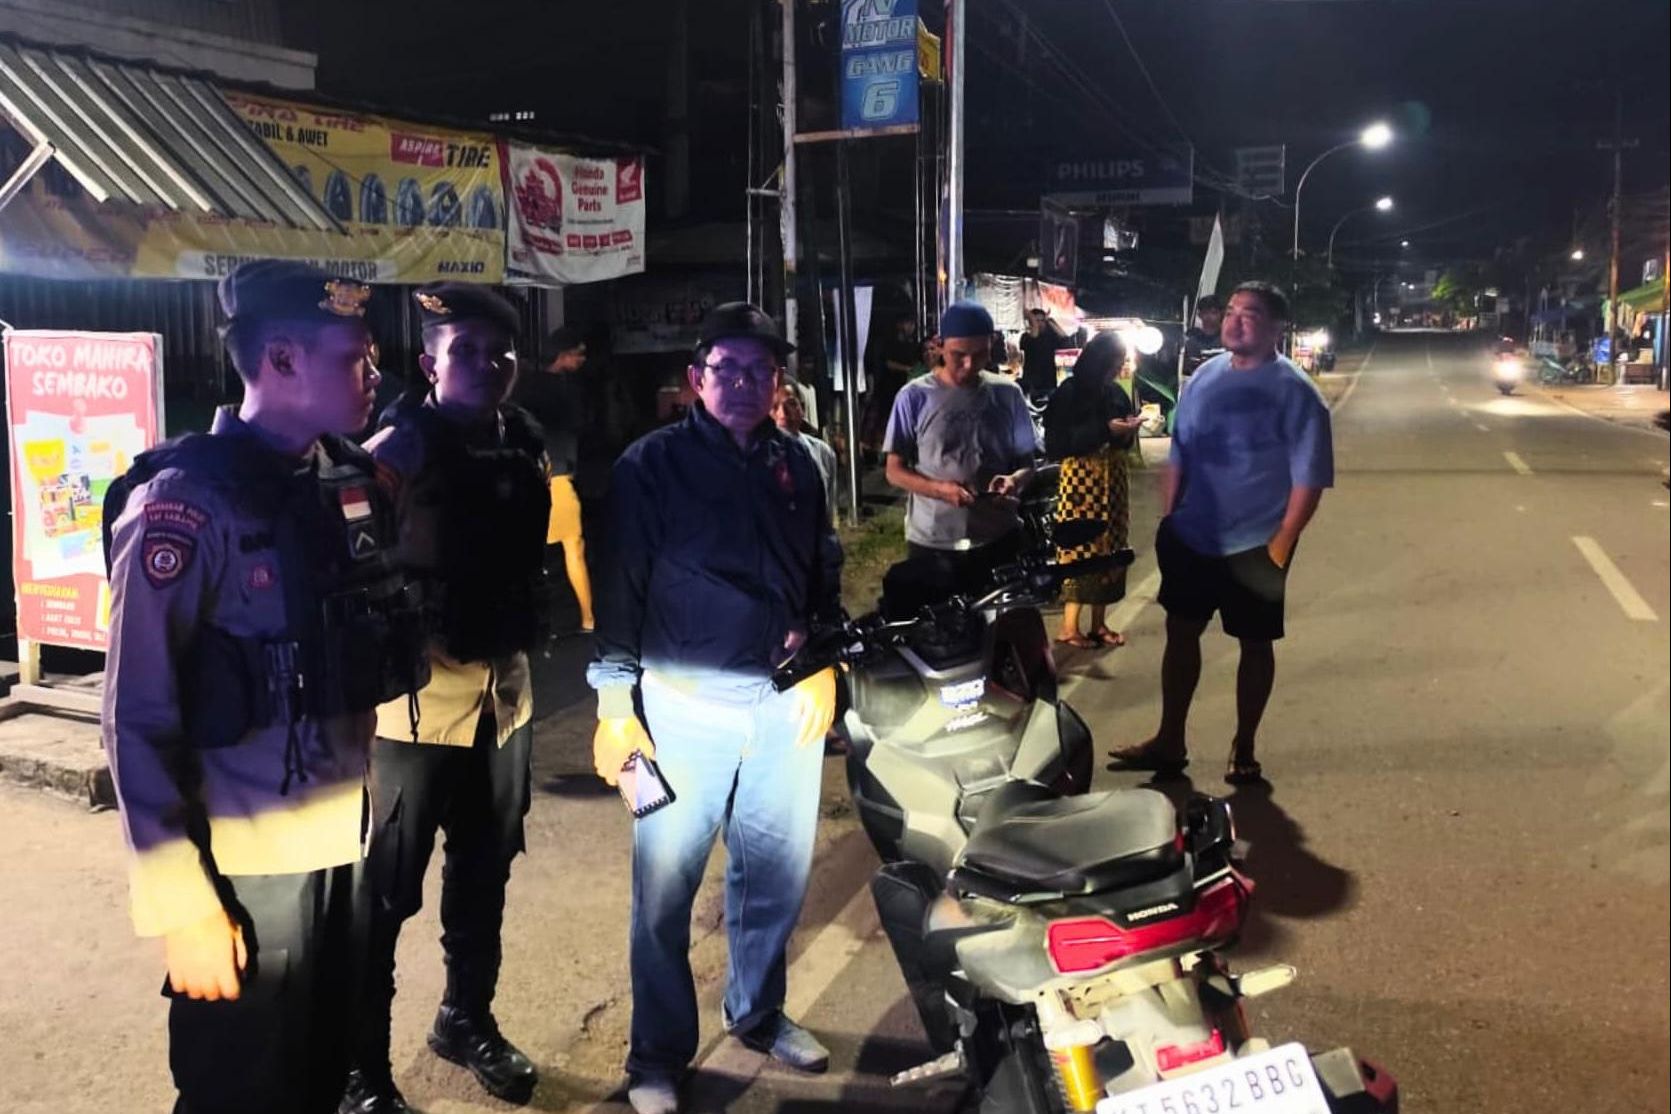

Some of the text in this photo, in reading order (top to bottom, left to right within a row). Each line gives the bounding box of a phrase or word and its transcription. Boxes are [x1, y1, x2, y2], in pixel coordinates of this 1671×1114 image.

[846, 18, 917, 43] MOTOR
[863, 80, 898, 119] 6
[286, 126, 294, 142] &
[298, 127, 328, 147] AWET
[447, 144, 490, 167] TIRE
[575, 166, 604, 180] Honda
[1058, 160, 1145, 179] PHILIPS
[571, 181, 608, 196] Genuine
[578, 198, 602, 212] Parts
[325, 259, 377, 280] MOTOR
[10, 343, 149, 373] TOKO MAHIRA
[32, 370, 128, 399] SEMBAKO
[1127, 903, 1179, 921] HONDA
[1161, 1058, 1303, 1114] 5632 BBC
